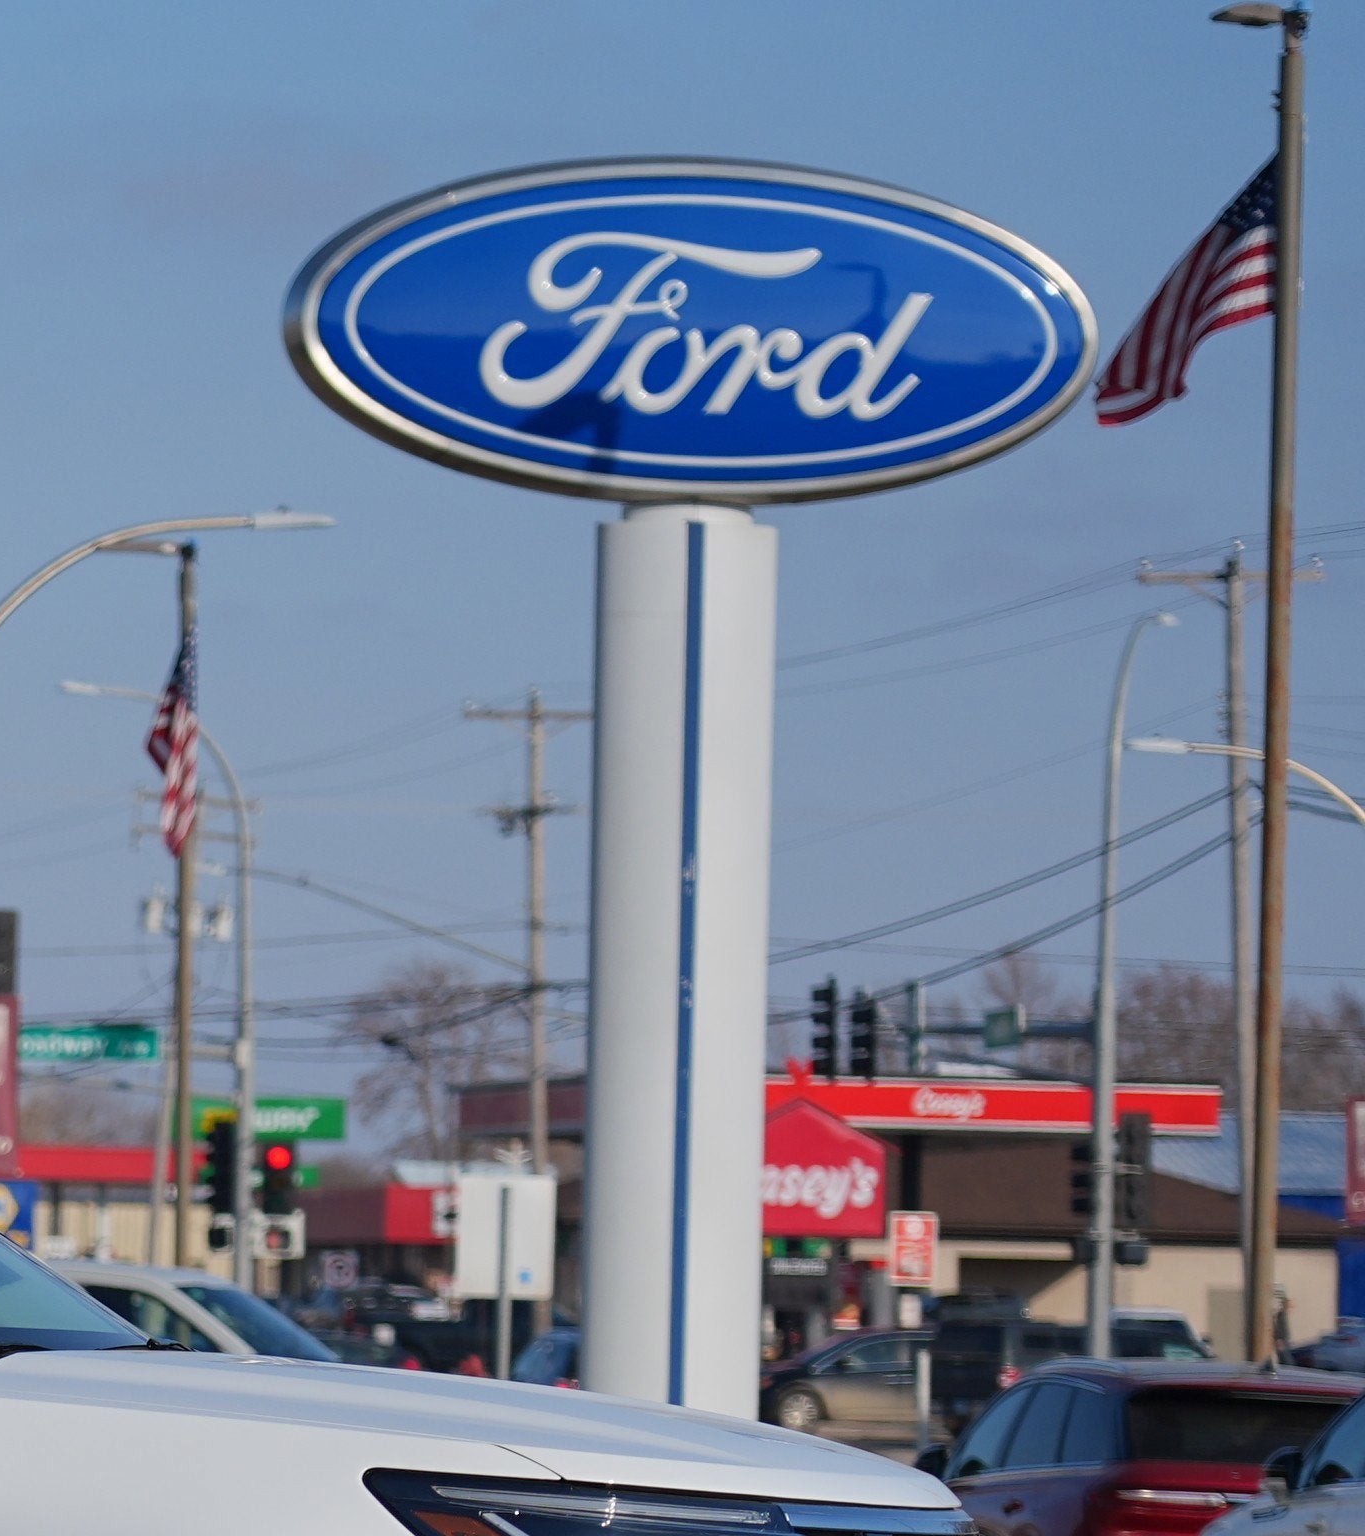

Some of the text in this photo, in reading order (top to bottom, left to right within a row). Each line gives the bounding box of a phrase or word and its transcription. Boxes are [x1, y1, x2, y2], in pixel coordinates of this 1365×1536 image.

[480, 231, 933, 421] Ford
[910, 1087, 987, 1122] Casey's
[762, 1157, 879, 1219] asey's
